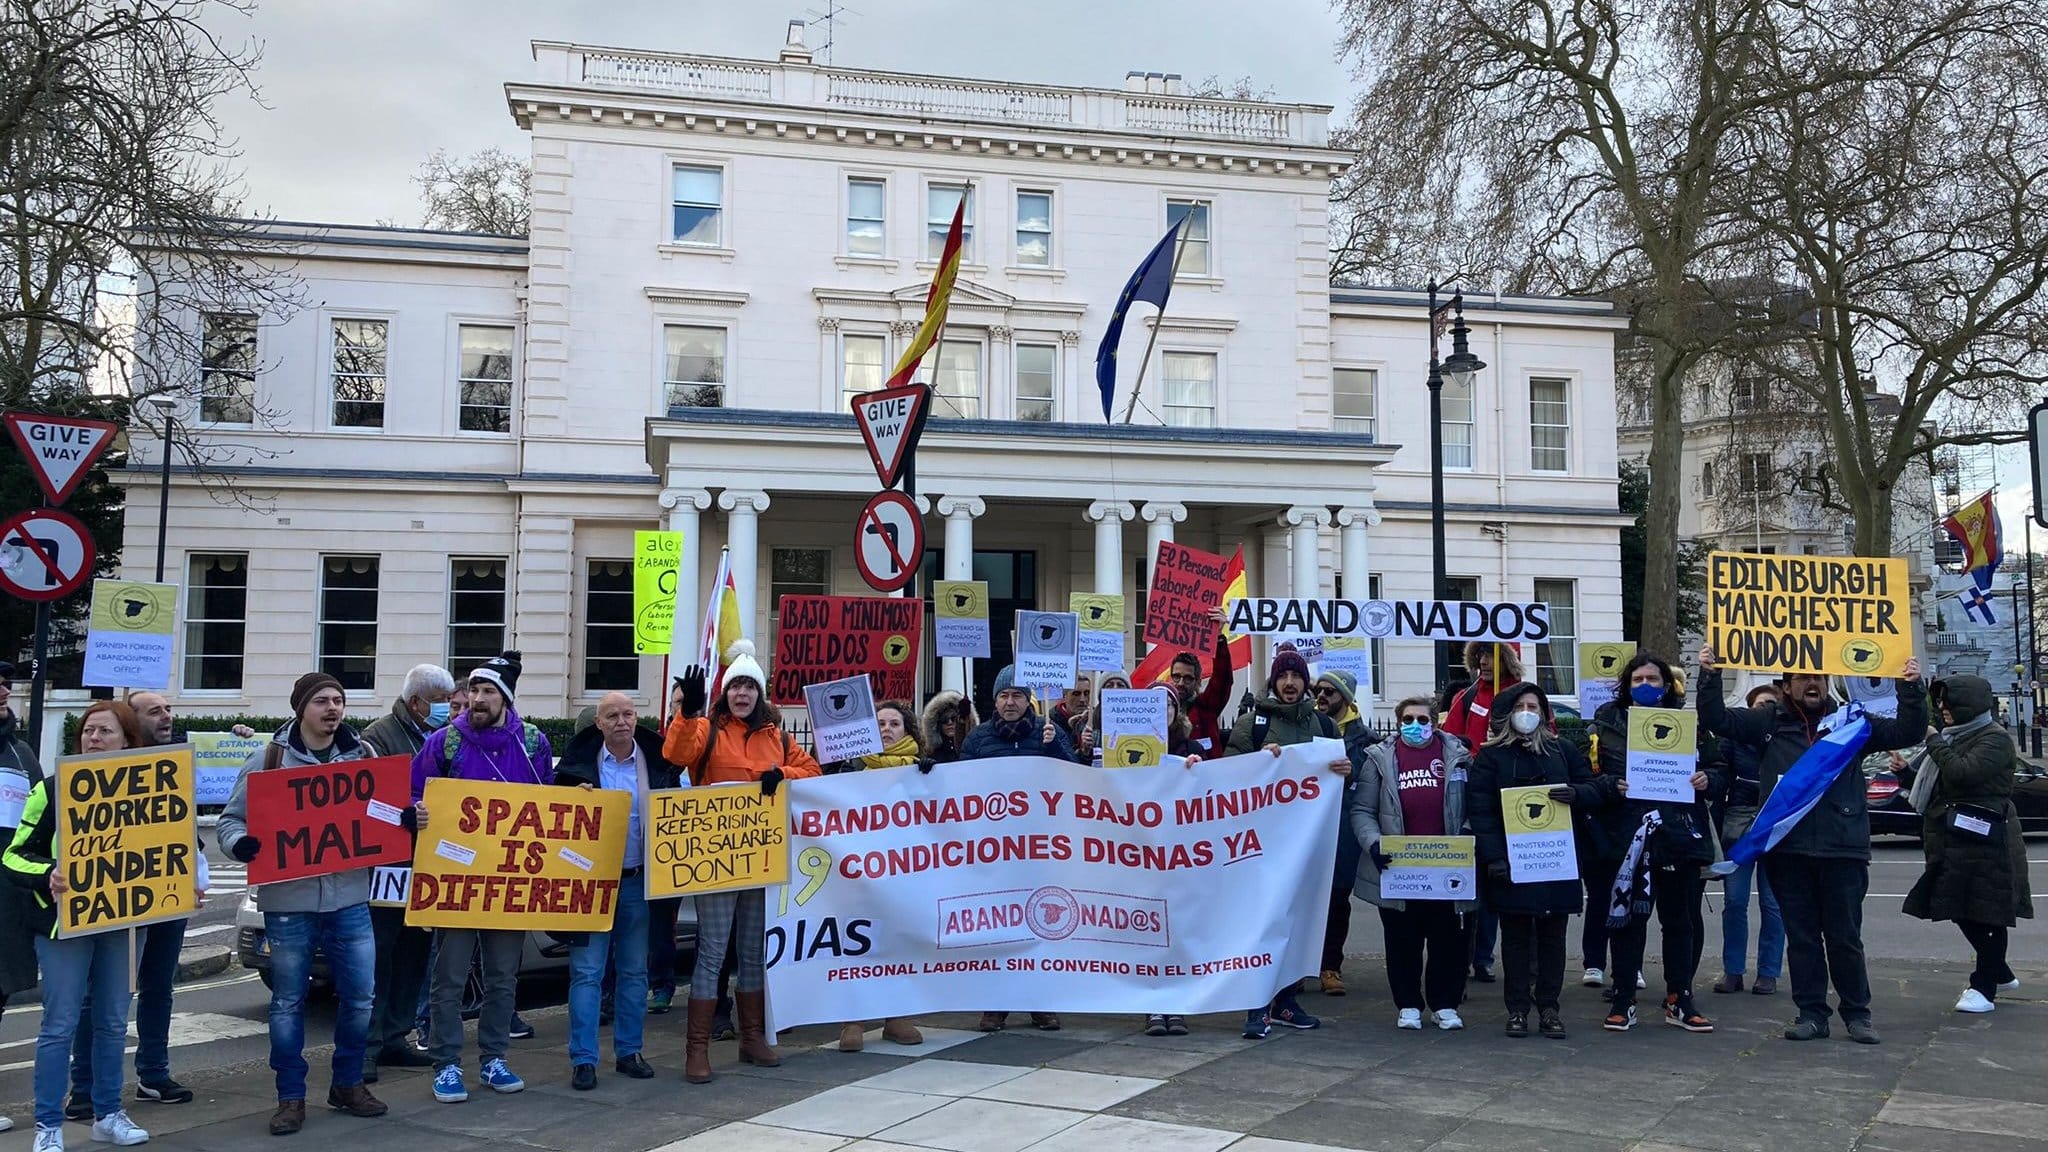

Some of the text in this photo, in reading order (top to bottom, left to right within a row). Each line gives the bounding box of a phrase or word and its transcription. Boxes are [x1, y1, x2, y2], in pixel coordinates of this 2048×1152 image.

[868, 398, 906, 421] GIVE
[30, 424, 91, 445] GIVE
[876, 423, 900, 438] WAY
[42, 446, 81, 461] WAY
[1157, 545, 1227, 582] El Personal
[1712, 556, 1887, 595] EDINBURGH
[1154, 567, 1218, 606] Laboral en
[782, 600, 830, 630] ¡BAJO
[1150, 596, 1214, 629] el Exterior
[1712, 591, 1899, 635] MANCHESTER
[95, 641, 165, 651] SPANISH FOREIGN
[1147, 614, 1212, 653] EXISTE
[1296, 638, 1322, 647] DIAS
[1713, 627, 1823, 670] LONDON
[95, 654, 162, 663] ABANDONMENT
[781, 633, 870, 666] SUELDOS
[1024, 661, 1068, 669] TRABAJAMOS
[1300, 650, 1323, 658] UELGA
[1042, 670, 1068, 679] ESPAÑA
[824, 727, 871, 742] TRABAJAMOS
[826, 737, 873, 753] PARA ESPAÑA
[70, 760, 179, 802] OVER
[287, 769, 375, 811] TODO
[1398, 778, 1438, 790] RANATE
[1399, 769, 1432, 781] MAREA
[68, 794, 188, 835] WORKED
[656, 793, 762, 819] INFLATION
[1040, 790, 1063, 816] Y
[1074, 794, 1163, 828] BAJO
[1175, 776, 1321, 825] MÍNIMOS
[458, 796, 602, 841] SPAIN
[656, 811, 770, 837] KEEPS RISING
[70, 829, 123, 857] and
[276, 819, 382, 870] MAL
[496, 839, 547, 874] IS
[655, 827, 783, 864] OUR SALARIES
[839, 828, 1263, 880] CONDICIONES DIGNAS YA
[1512, 840, 1555, 849] MINISTERIO
[1518, 851, 1565, 859] ABANDONO
[69, 843, 189, 893] UNDER
[672, 852, 757, 888] DON'T
[70, 885, 154, 927] PAID
[409, 872, 619, 915] DIFFERENT
[828, 952, 1273, 982] PERSONAL LABORAL SIN CONVENIO EN EL EXTERIOR
